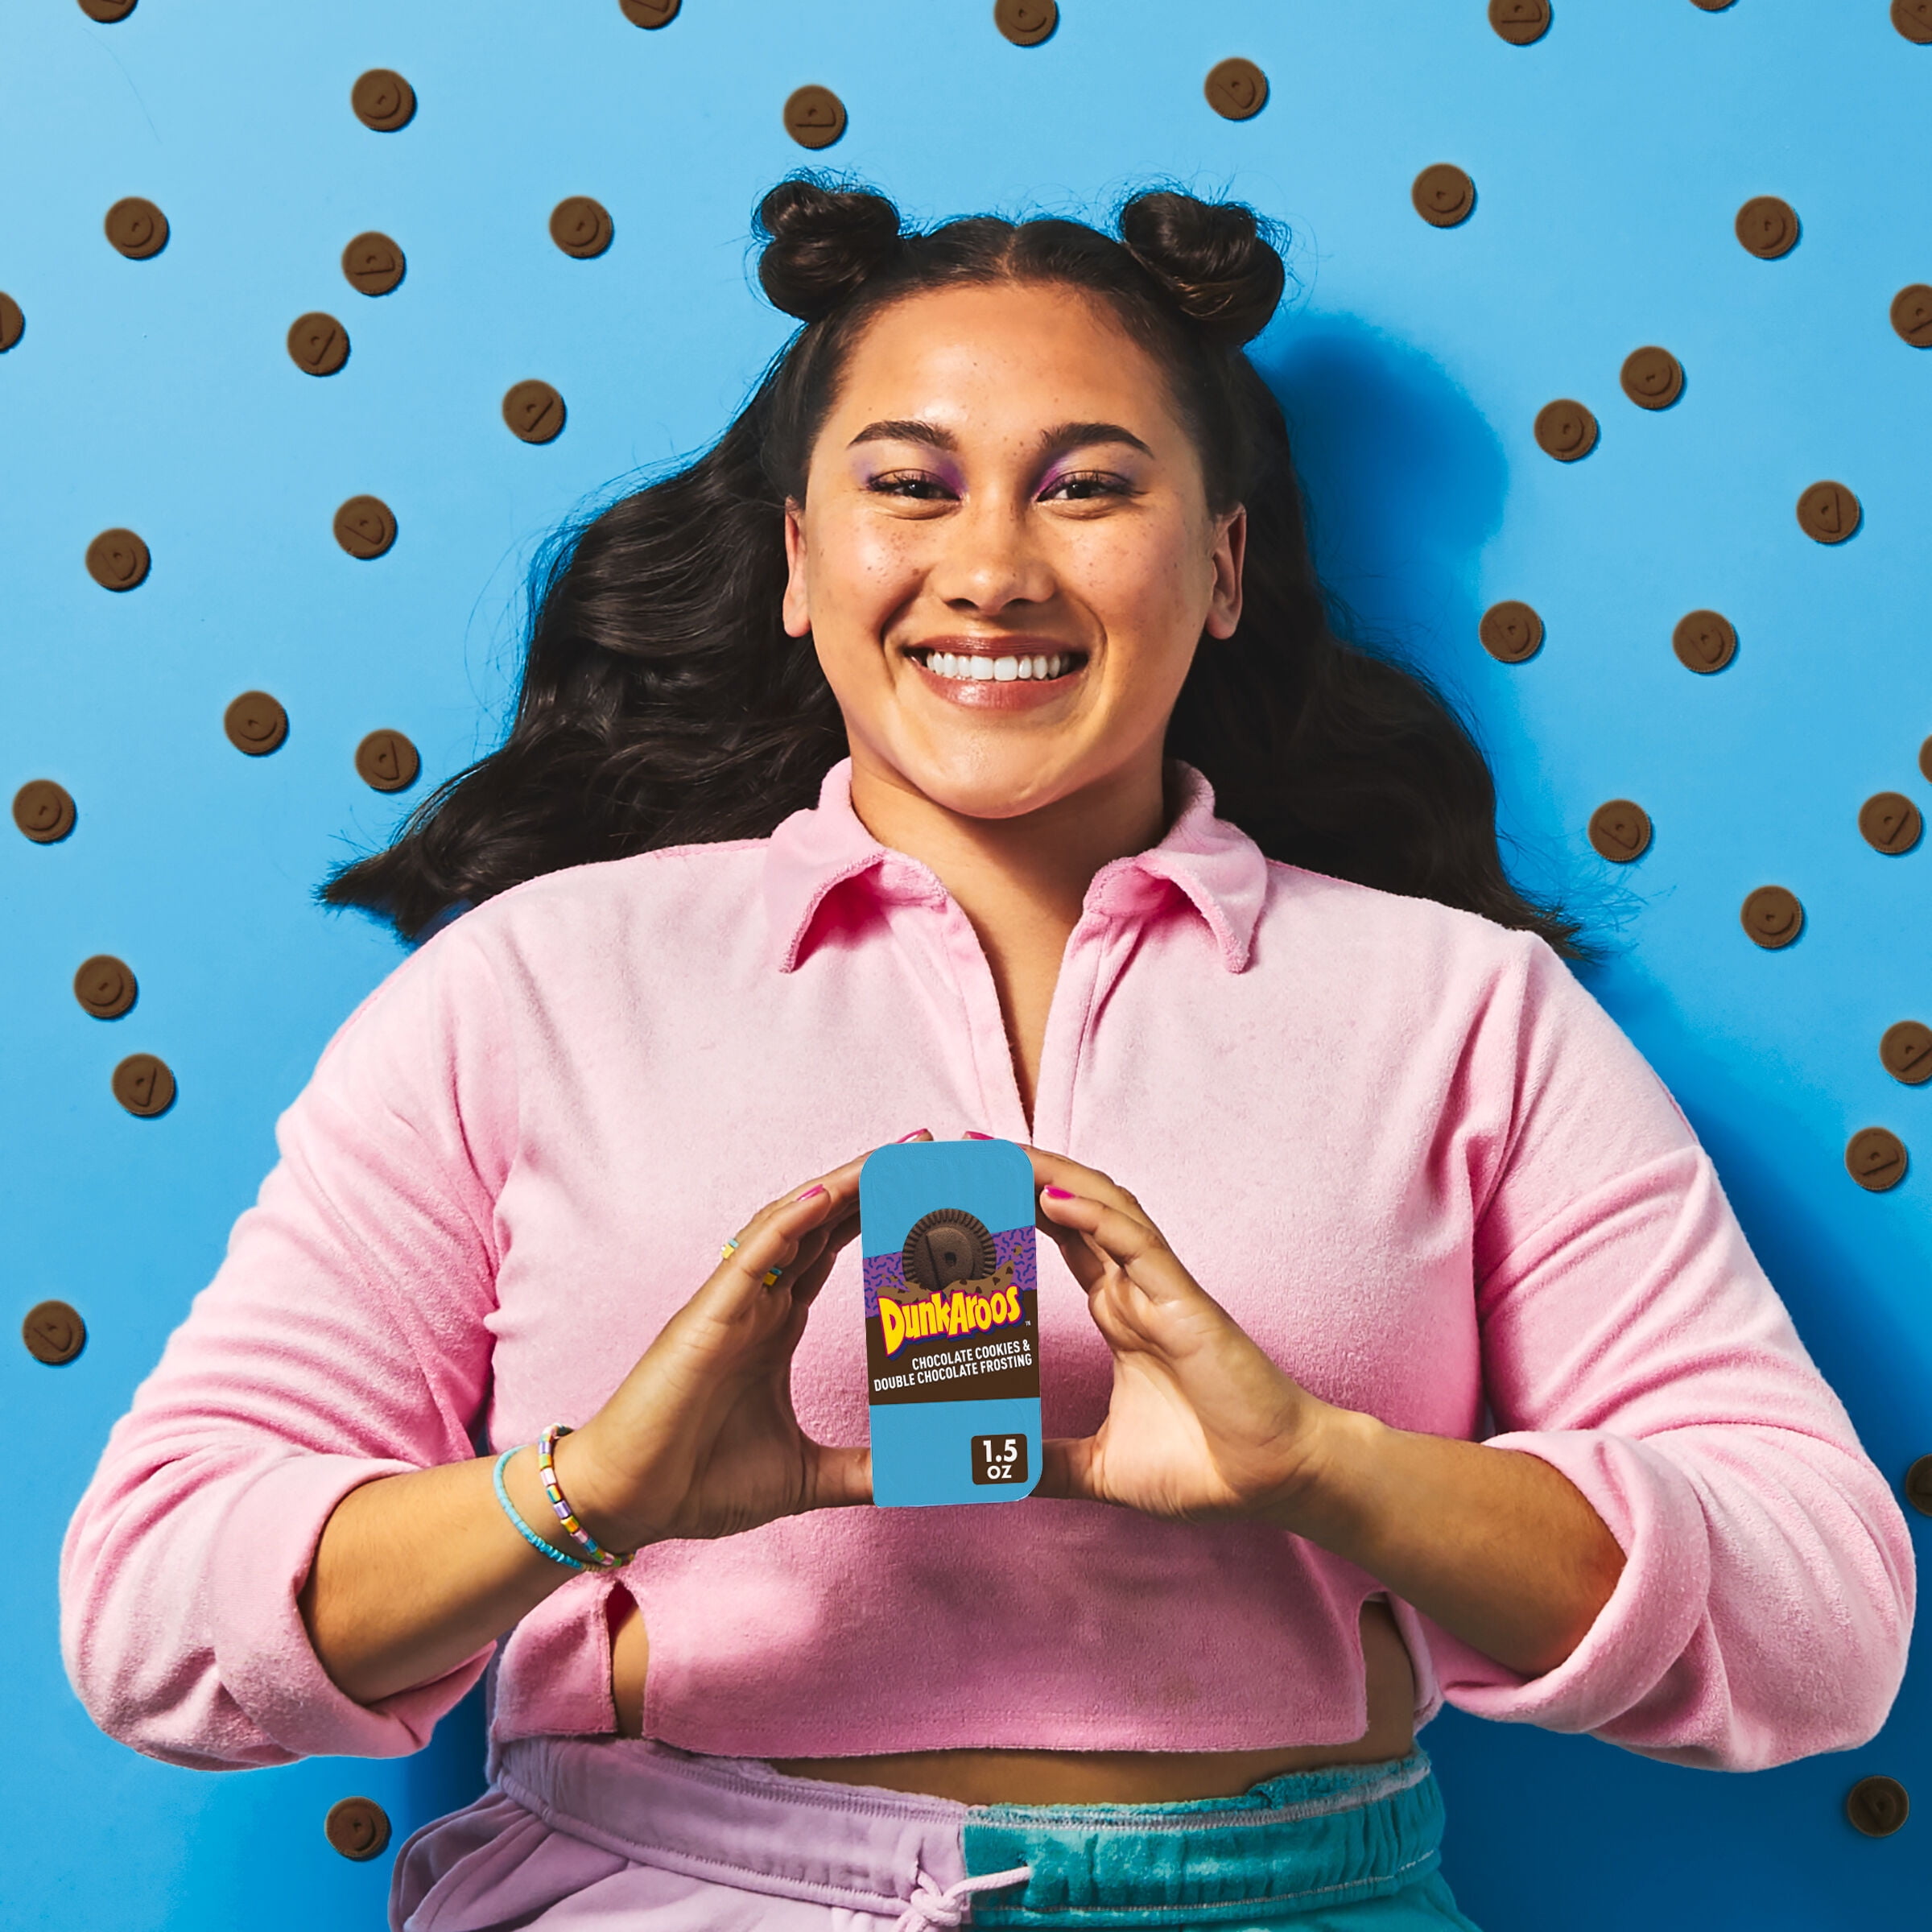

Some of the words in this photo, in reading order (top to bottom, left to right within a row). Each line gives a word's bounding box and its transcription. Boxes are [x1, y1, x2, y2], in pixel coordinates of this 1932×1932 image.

[911, 1348, 974, 1371] CHOCOLATE
[975, 1340, 1021, 1360] COOKIES
[1022, 1339, 1031, 1352] &
[873, 1373, 916, 1392] DOUBLE
[917, 1362, 979, 1384] CHOCOLATE
[980, 1352, 1033, 1374] FROSTING
[983, 1439, 1018, 1463] 1.5
